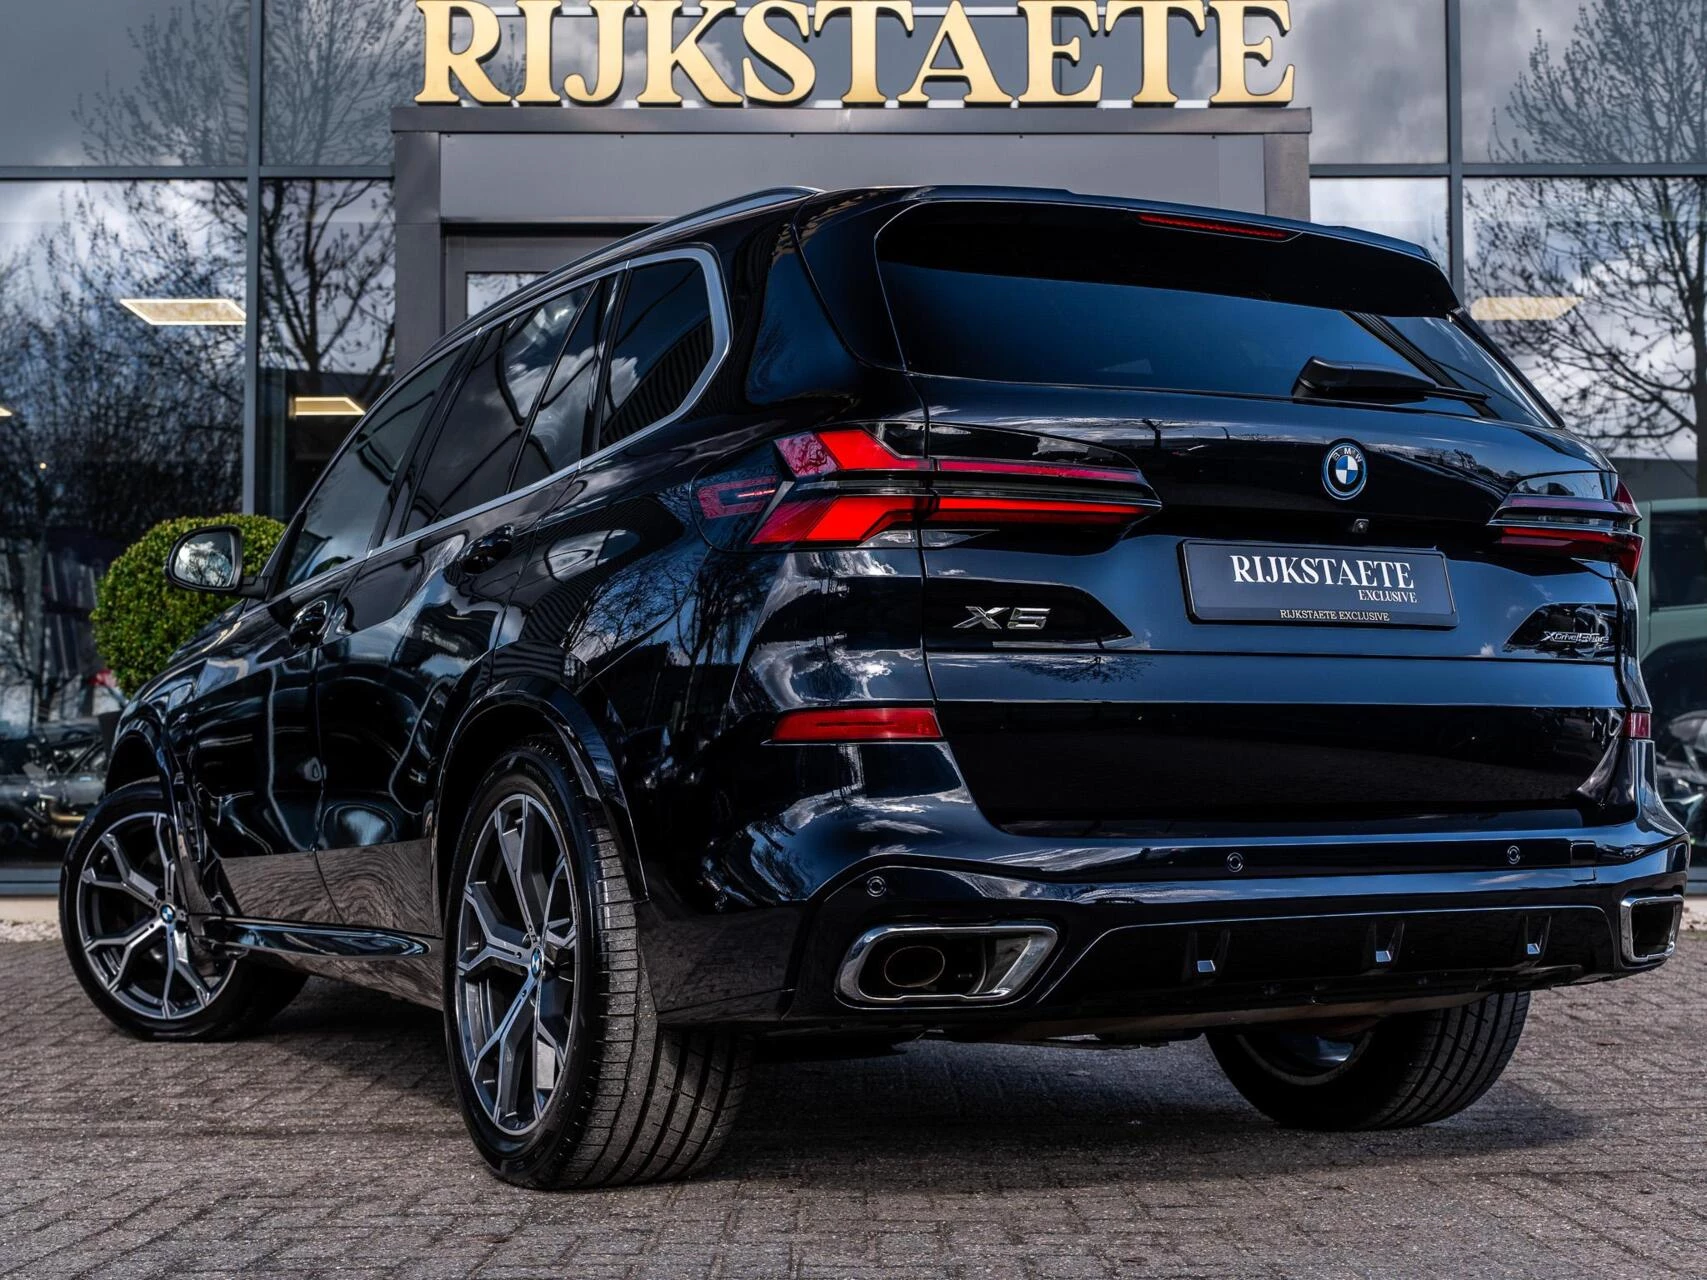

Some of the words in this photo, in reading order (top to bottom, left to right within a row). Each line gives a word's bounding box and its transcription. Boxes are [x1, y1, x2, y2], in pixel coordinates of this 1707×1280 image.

[414, 0, 1296, 106] RIJKSTAETE
[1331, 447, 1363, 463] BMW
[1230, 554, 1415, 589] RIJKSTAETE
[1358, 589, 1418, 603] EXCLUSIVE
[953, 605, 1051, 630] X5
[1279, 609, 1338, 620] RIJKSTAETE
[1338, 610, 1391, 622] EXCLUSIVE
